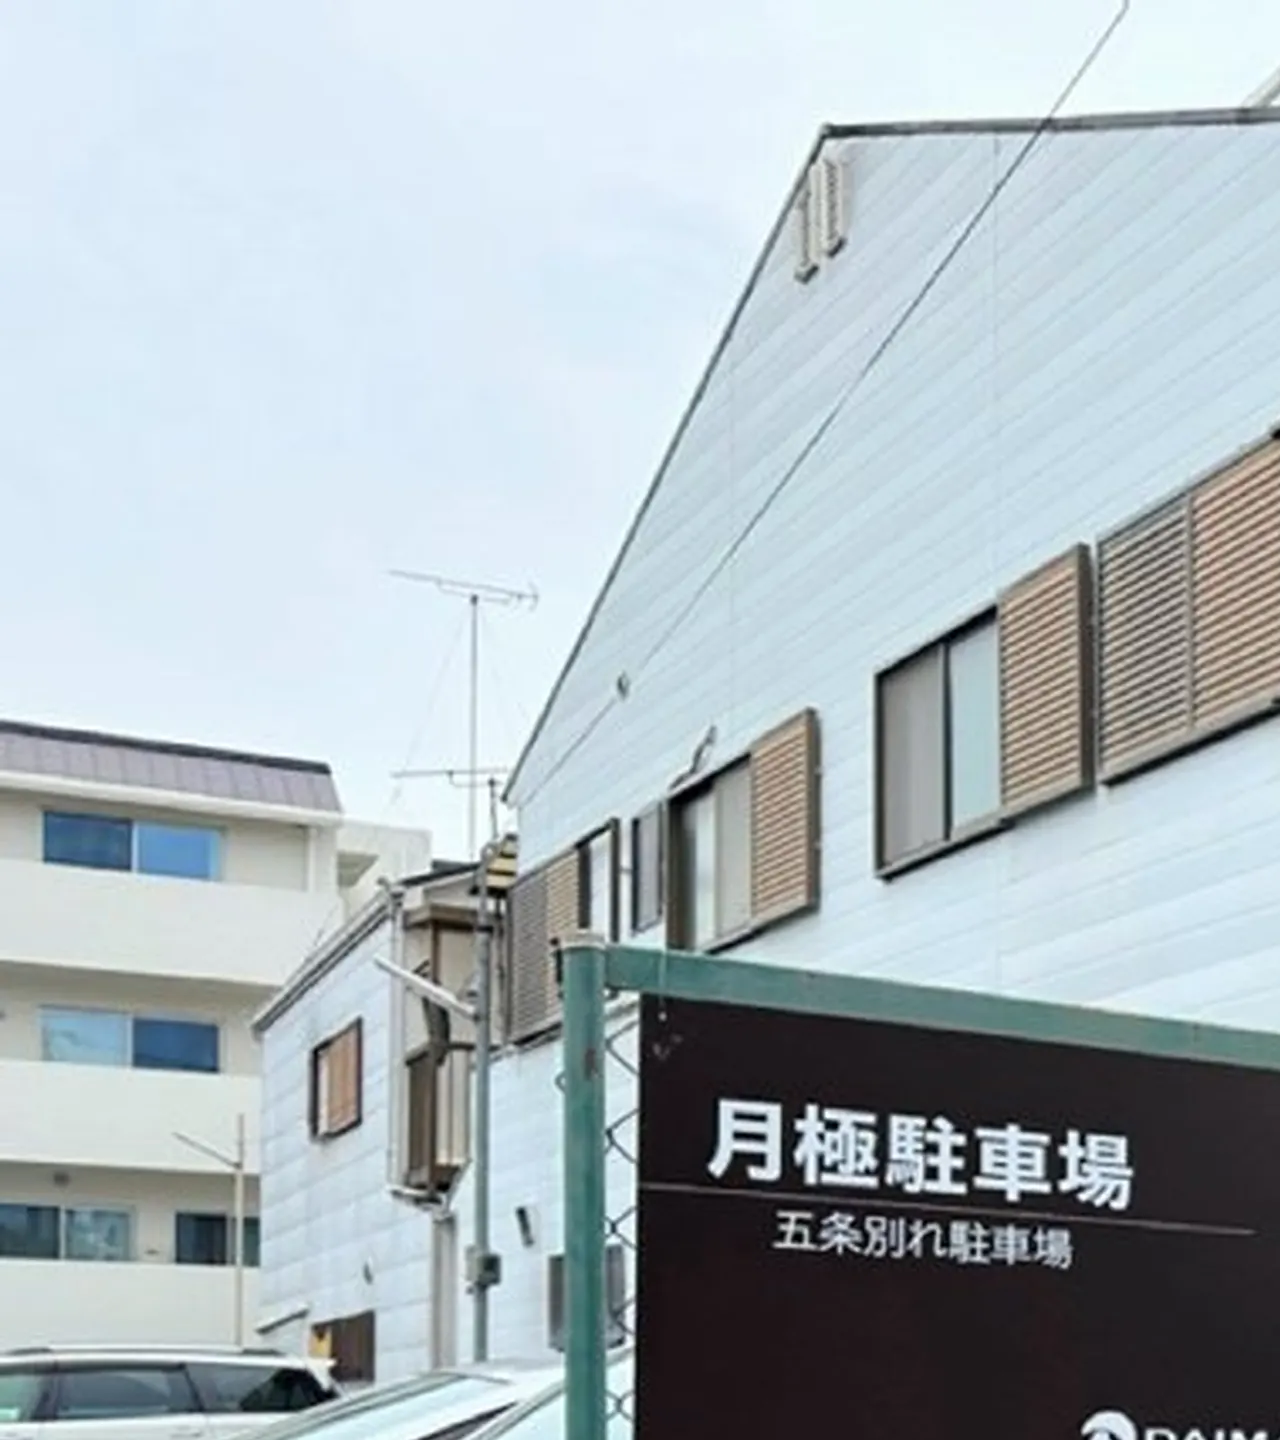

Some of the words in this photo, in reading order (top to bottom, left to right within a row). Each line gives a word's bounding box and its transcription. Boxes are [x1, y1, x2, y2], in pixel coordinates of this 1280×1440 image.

[706, 1097, 1136, 1211] 月極駐車場
[772, 1208, 1075, 1270] 五条別れ駐車場
